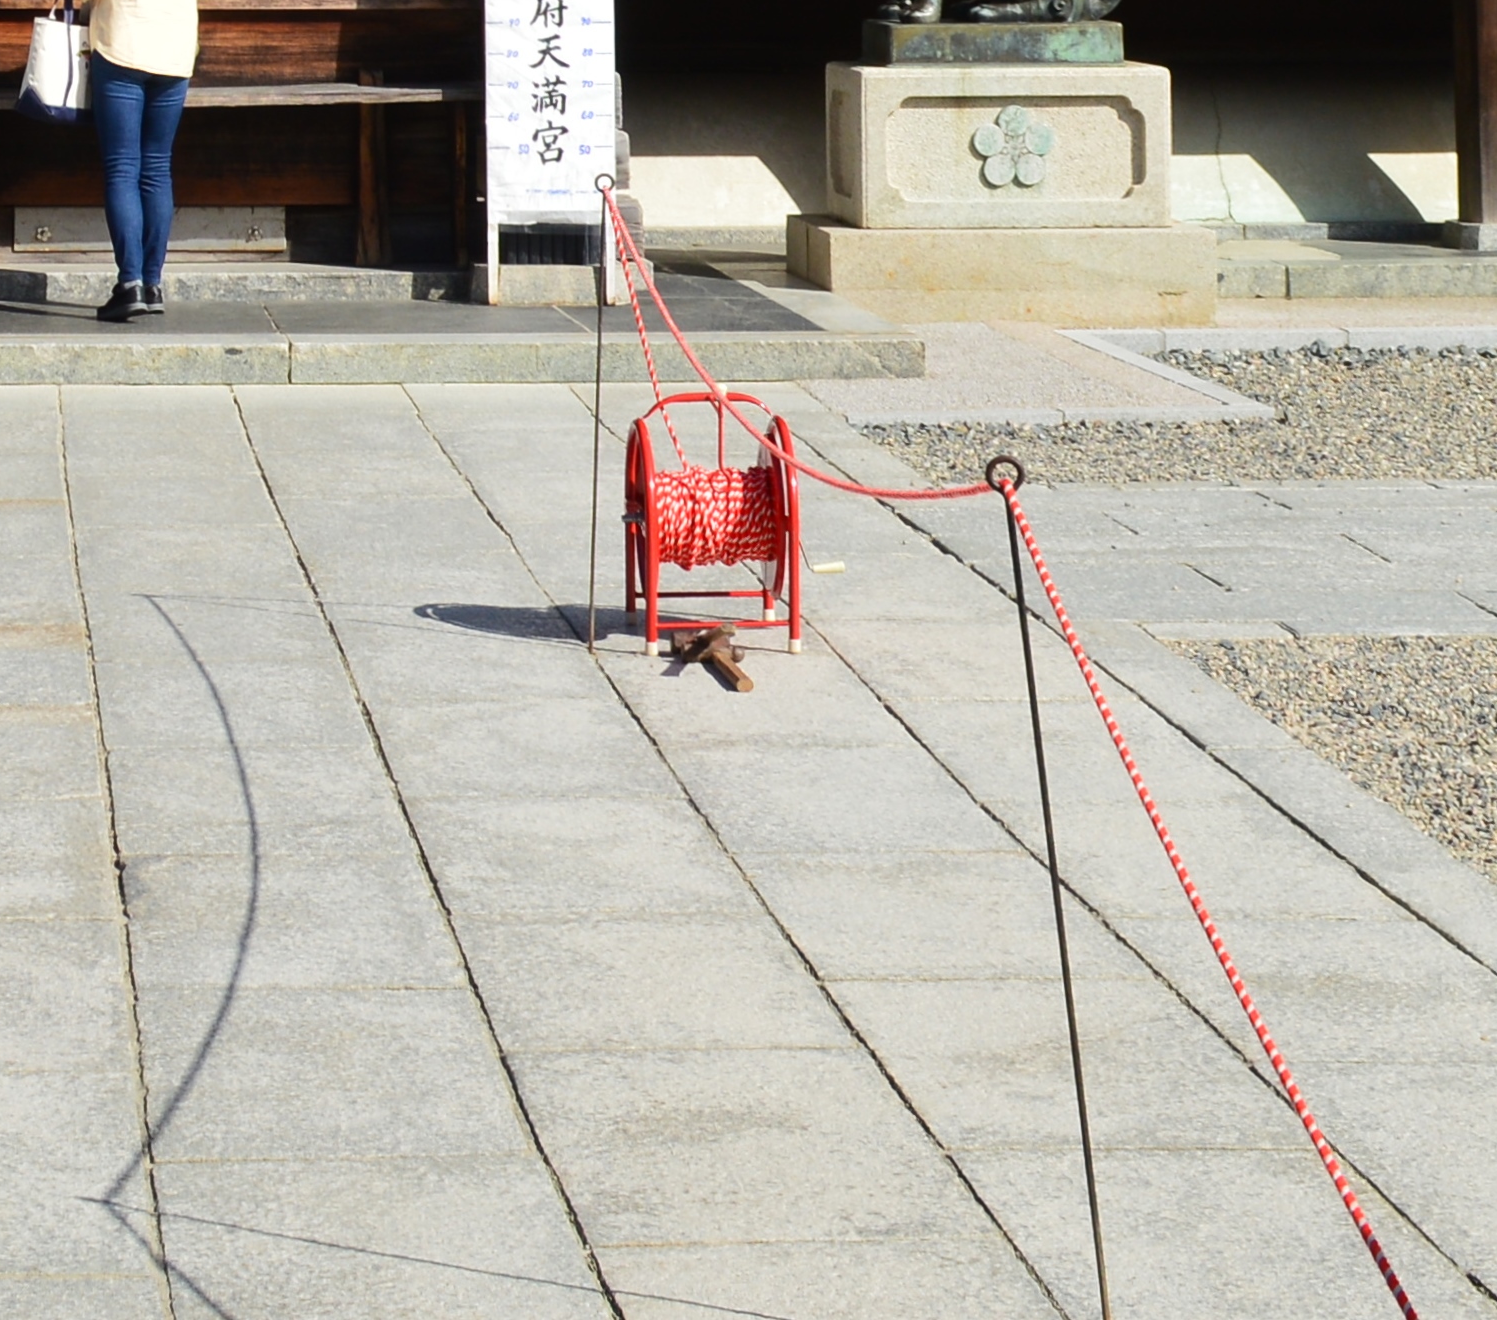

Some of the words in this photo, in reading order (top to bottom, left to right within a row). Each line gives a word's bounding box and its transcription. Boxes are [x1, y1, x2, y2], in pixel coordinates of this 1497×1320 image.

[509, 18, 520, 27] 90
[581, 17, 592, 26] 90
[506, 50, 519, 58] 80
[582, 48, 593, 57] 80
[507, 81, 519, 89] 70
[582, 80, 594, 88] 70
[508, 112, 519, 122] 60
[581, 110, 594, 120] 60
[518, 144, 530, 155] 50
[579, 144, 591, 155] 50
